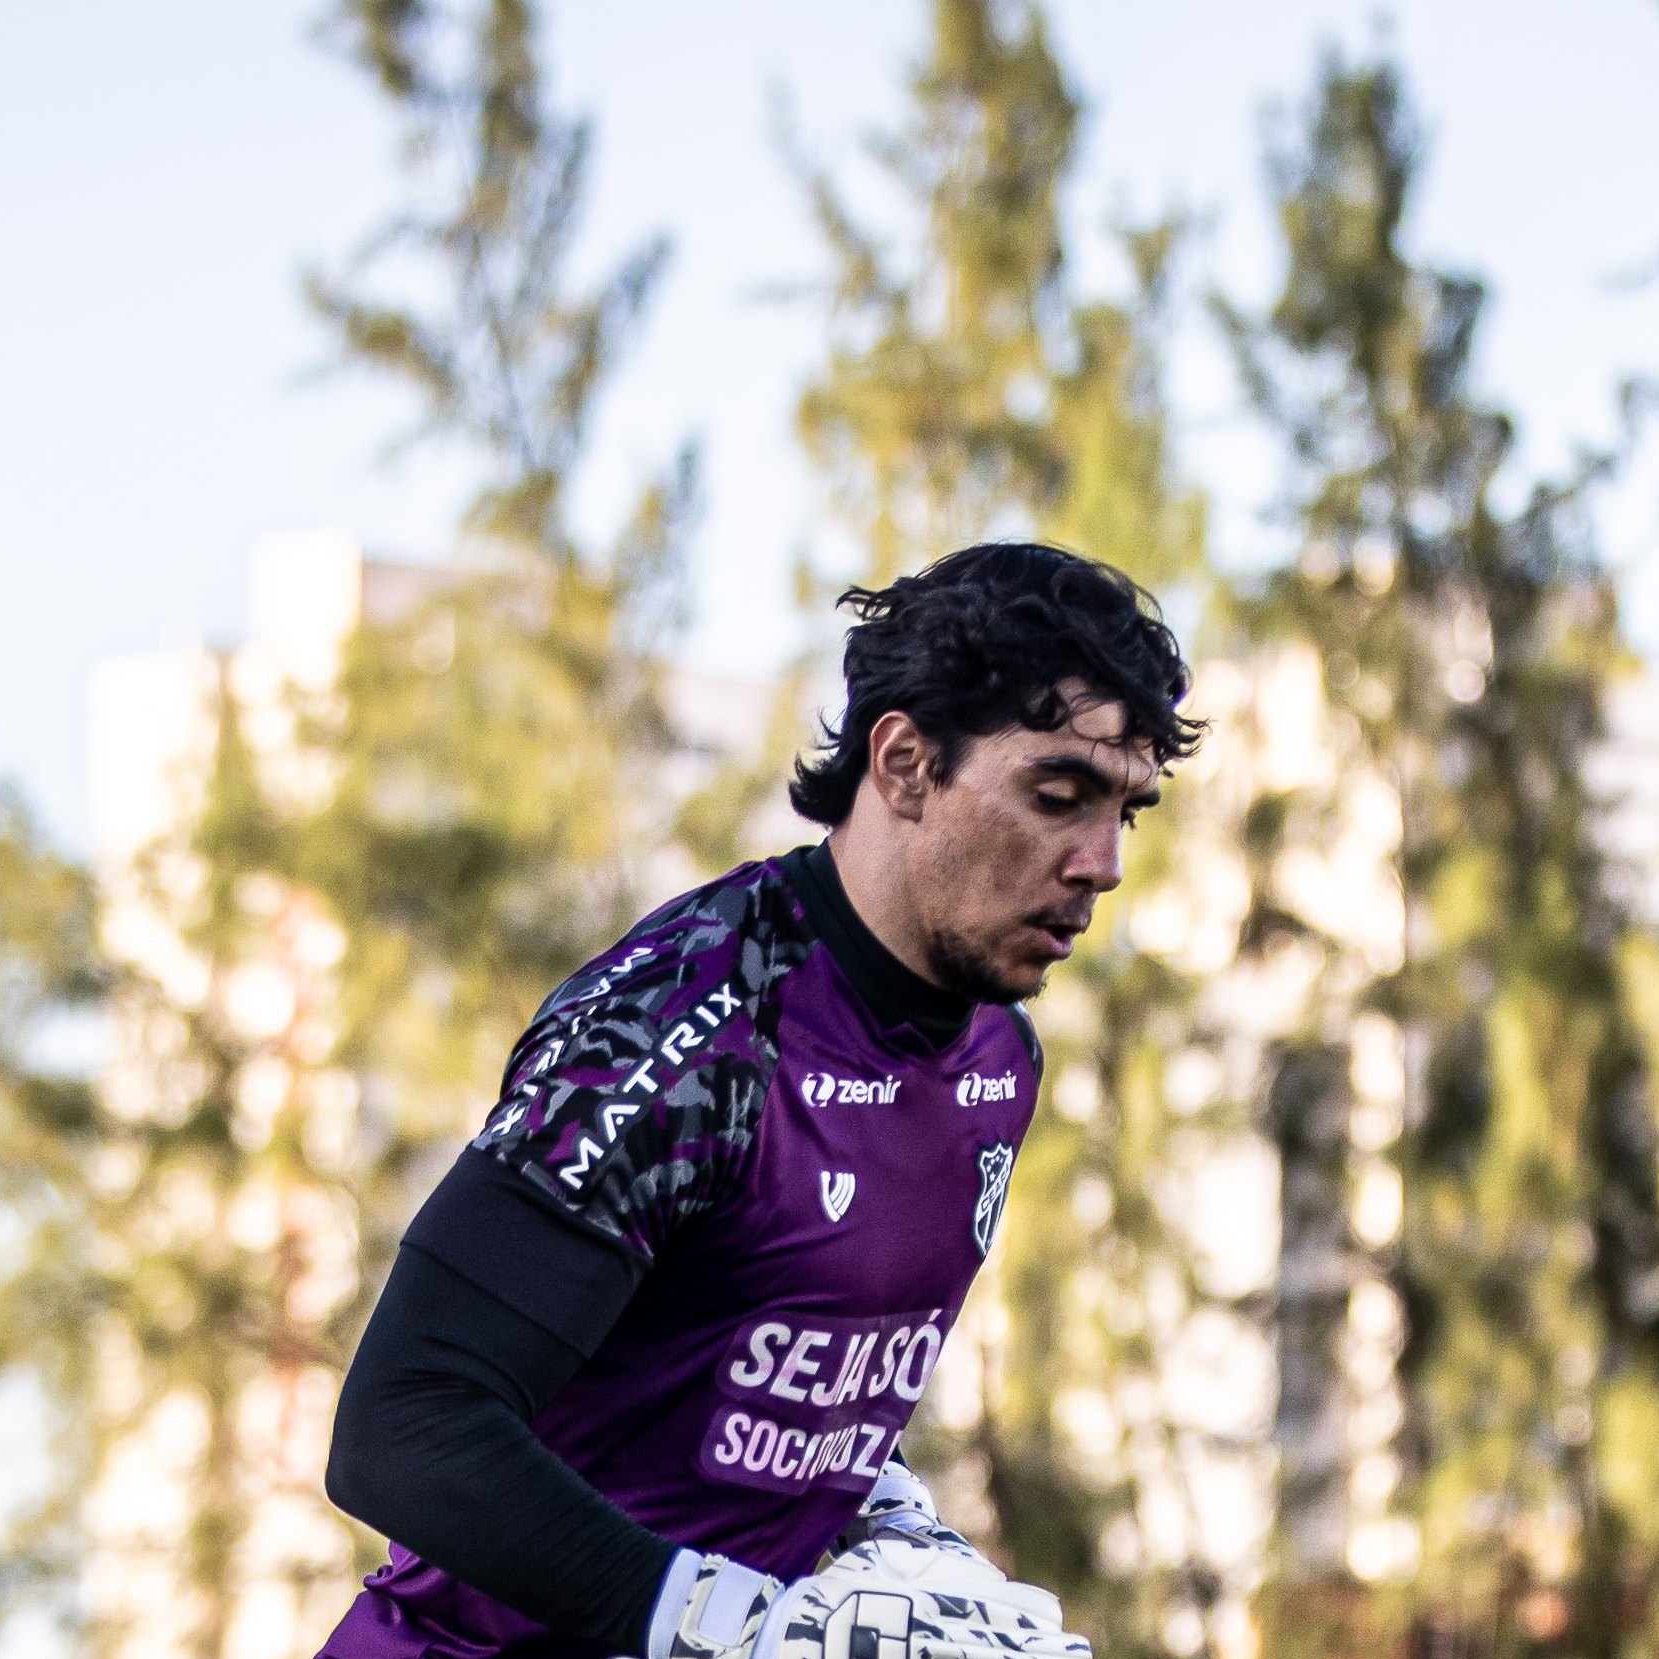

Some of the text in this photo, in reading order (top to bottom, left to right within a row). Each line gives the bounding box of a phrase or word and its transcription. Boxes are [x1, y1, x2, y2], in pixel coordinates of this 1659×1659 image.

[558, 982, 743, 1190] MATRIX
[837, 1073, 902, 1105] zenir
[982, 1069, 1018, 1102] zenir
[729, 1321, 880, 1407] SEJA
